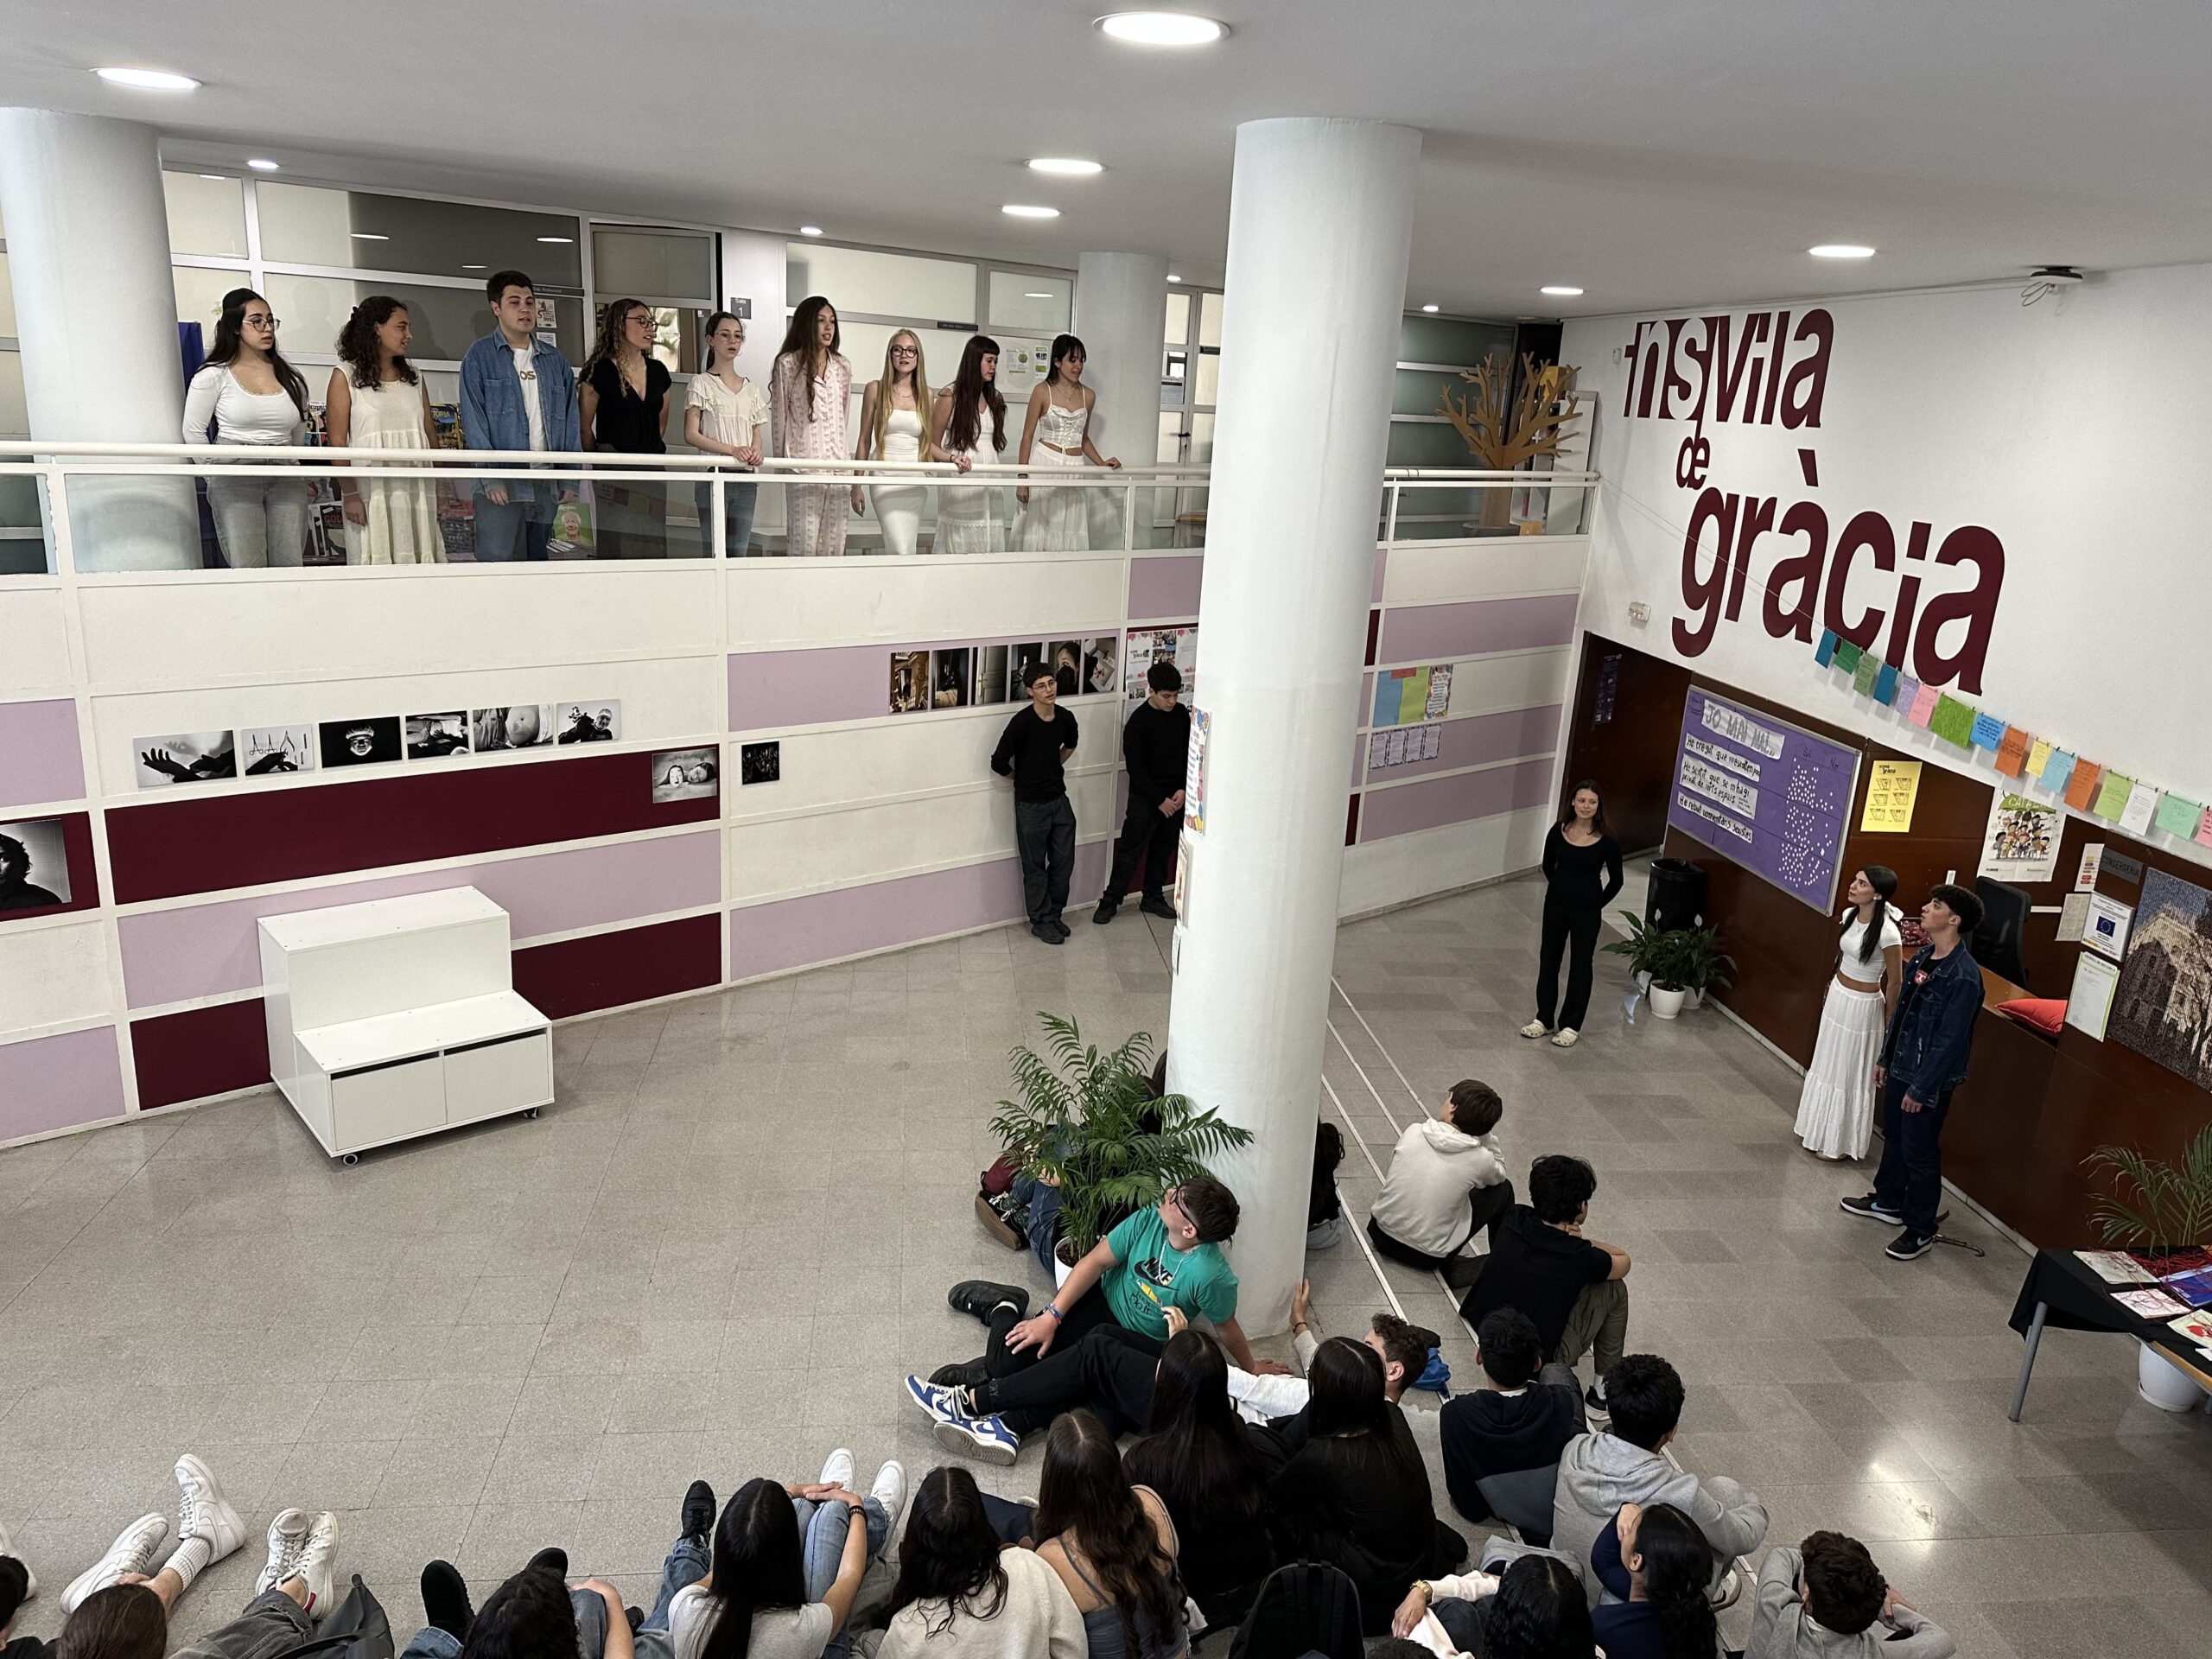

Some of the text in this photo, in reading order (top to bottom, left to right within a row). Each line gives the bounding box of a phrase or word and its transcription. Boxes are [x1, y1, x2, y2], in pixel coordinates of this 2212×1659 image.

[738, 307, 743, 317] 1
[430, 409, 451, 419] TORIA
[1676, 429, 1710, 490] de
[1672, 448, 2005, 696] gràcia
[1705, 704, 1722, 729] JO
[1687, 735, 1694, 747] He
[1716, 750, 1728, 761] que
[1683, 760, 1690, 771] He
[1709, 774, 1720, 785] que
[1679, 795, 1688, 806] He
